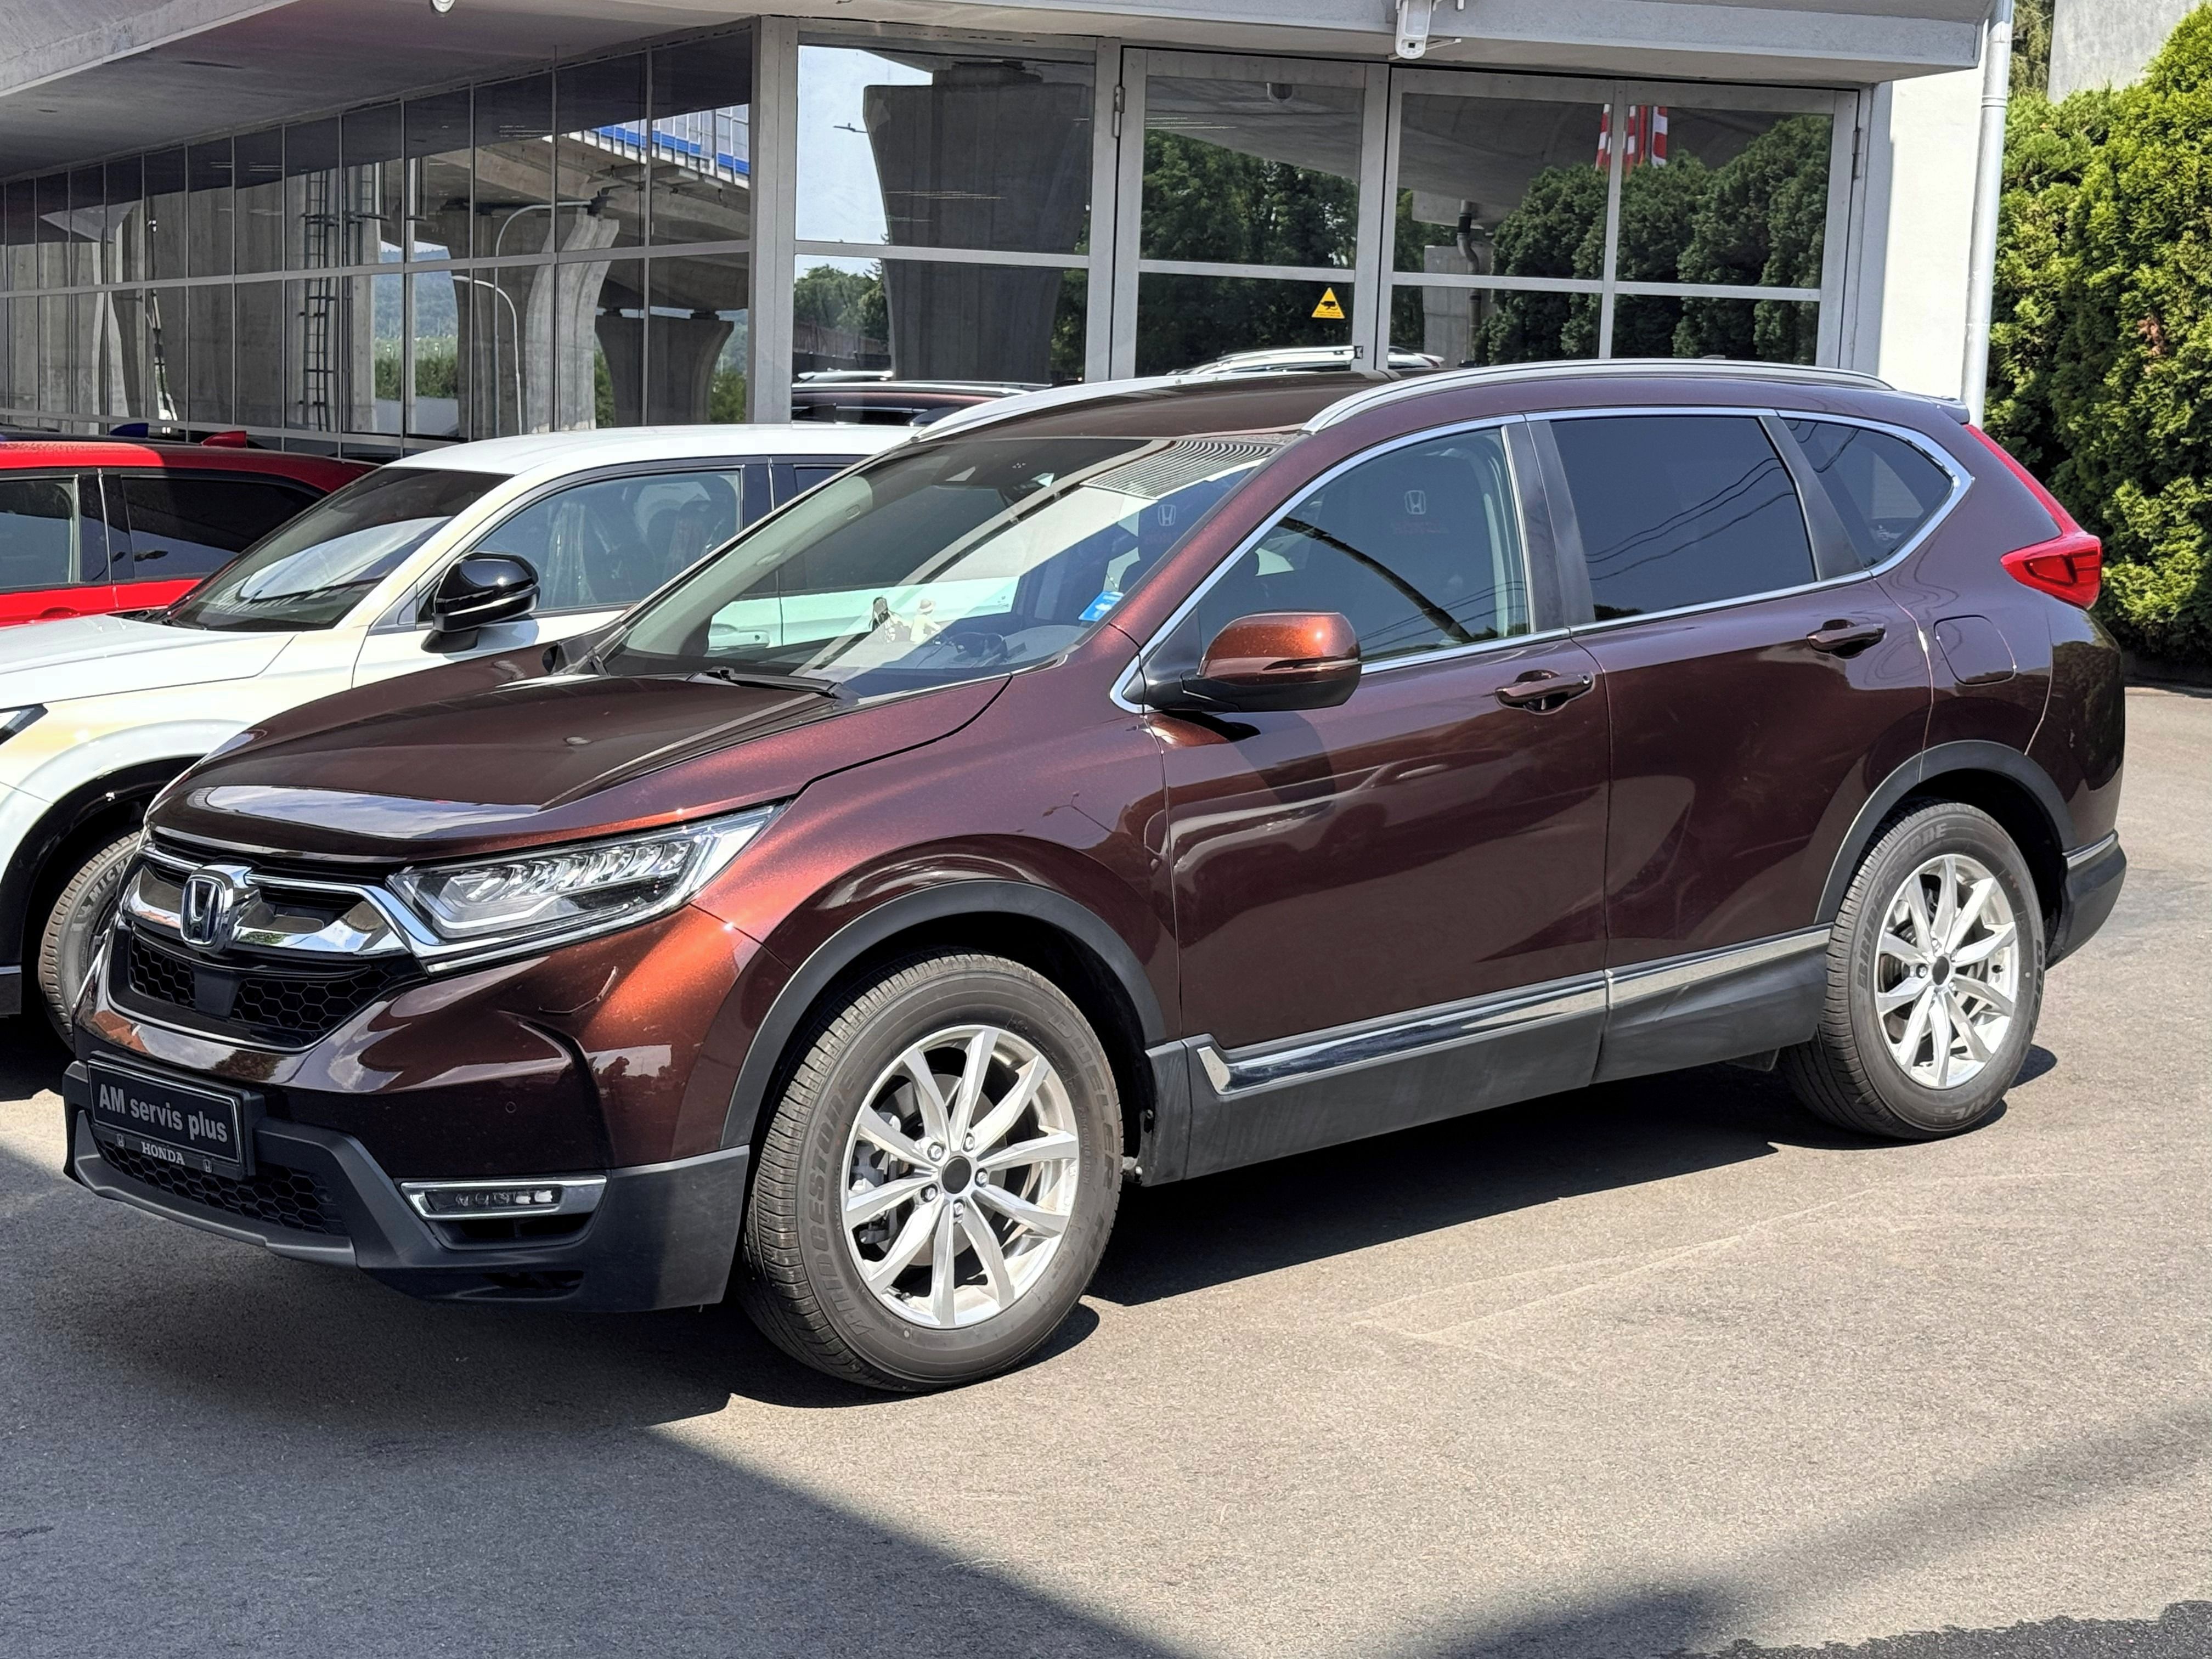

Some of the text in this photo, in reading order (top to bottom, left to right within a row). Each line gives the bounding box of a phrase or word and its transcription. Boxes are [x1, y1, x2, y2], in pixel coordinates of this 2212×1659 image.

[99, 1084, 228, 1143] AM servis plus
[140, 1141, 185, 1166] HONDA
